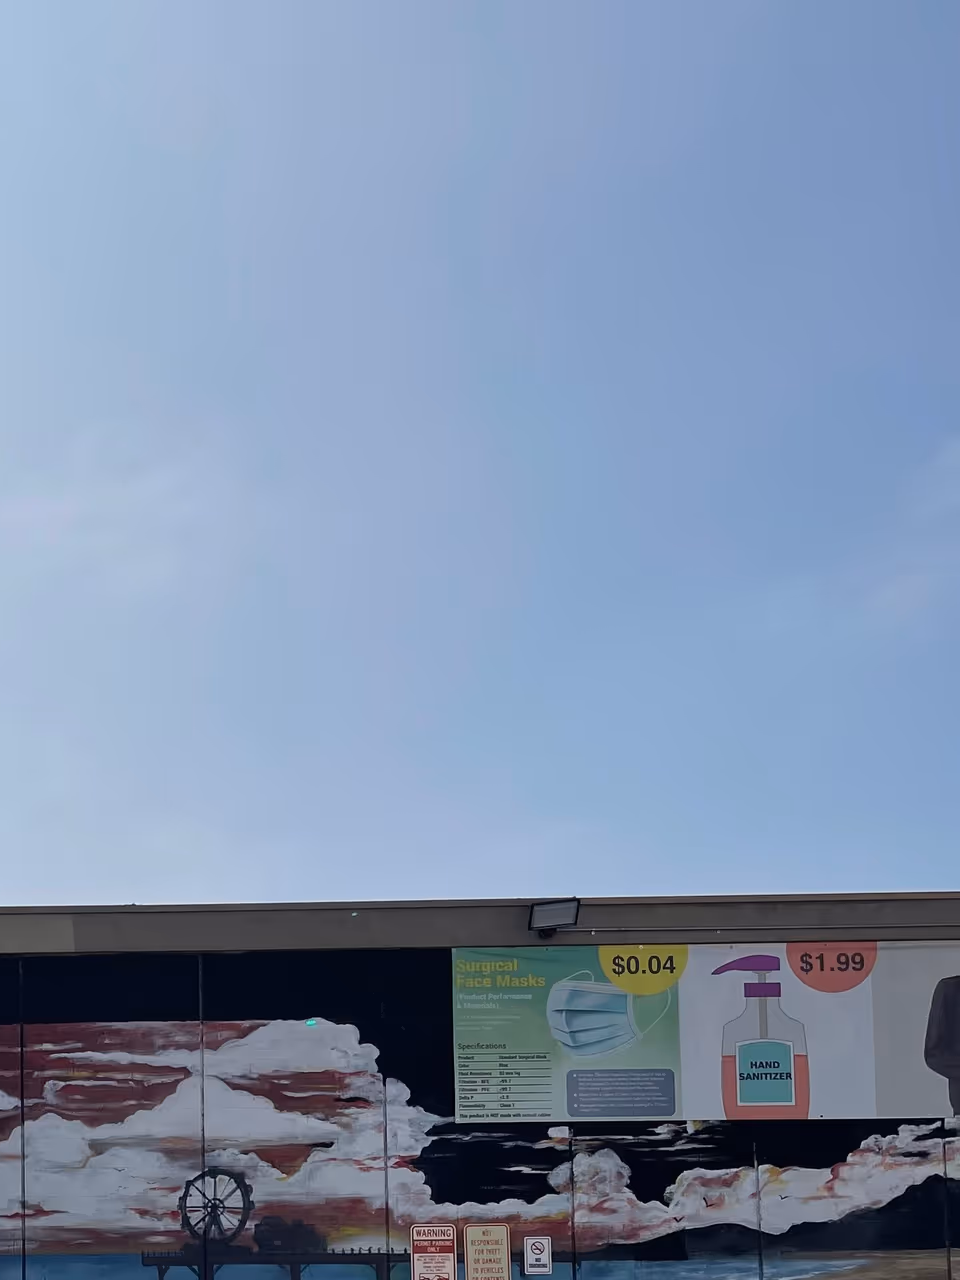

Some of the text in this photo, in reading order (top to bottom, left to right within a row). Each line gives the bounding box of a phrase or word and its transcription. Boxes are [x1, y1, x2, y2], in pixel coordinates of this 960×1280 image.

[455, 957, 518, 975] Surgical
[611, 955, 676, 977] $0.04
[799, 952, 866, 976] $1.99
[455, 973, 546, 988] Face Masks
[457, 1042, 507, 1051] Specifications
[749, 1061, 781, 1070] HAND
[739, 1072, 793, 1081] SANITIZER
[415, 1228, 452, 1238] WARNING
[481, 1257, 503, 1265] DAMAGE
[480, 1266, 504, 1274] VEHICLES
